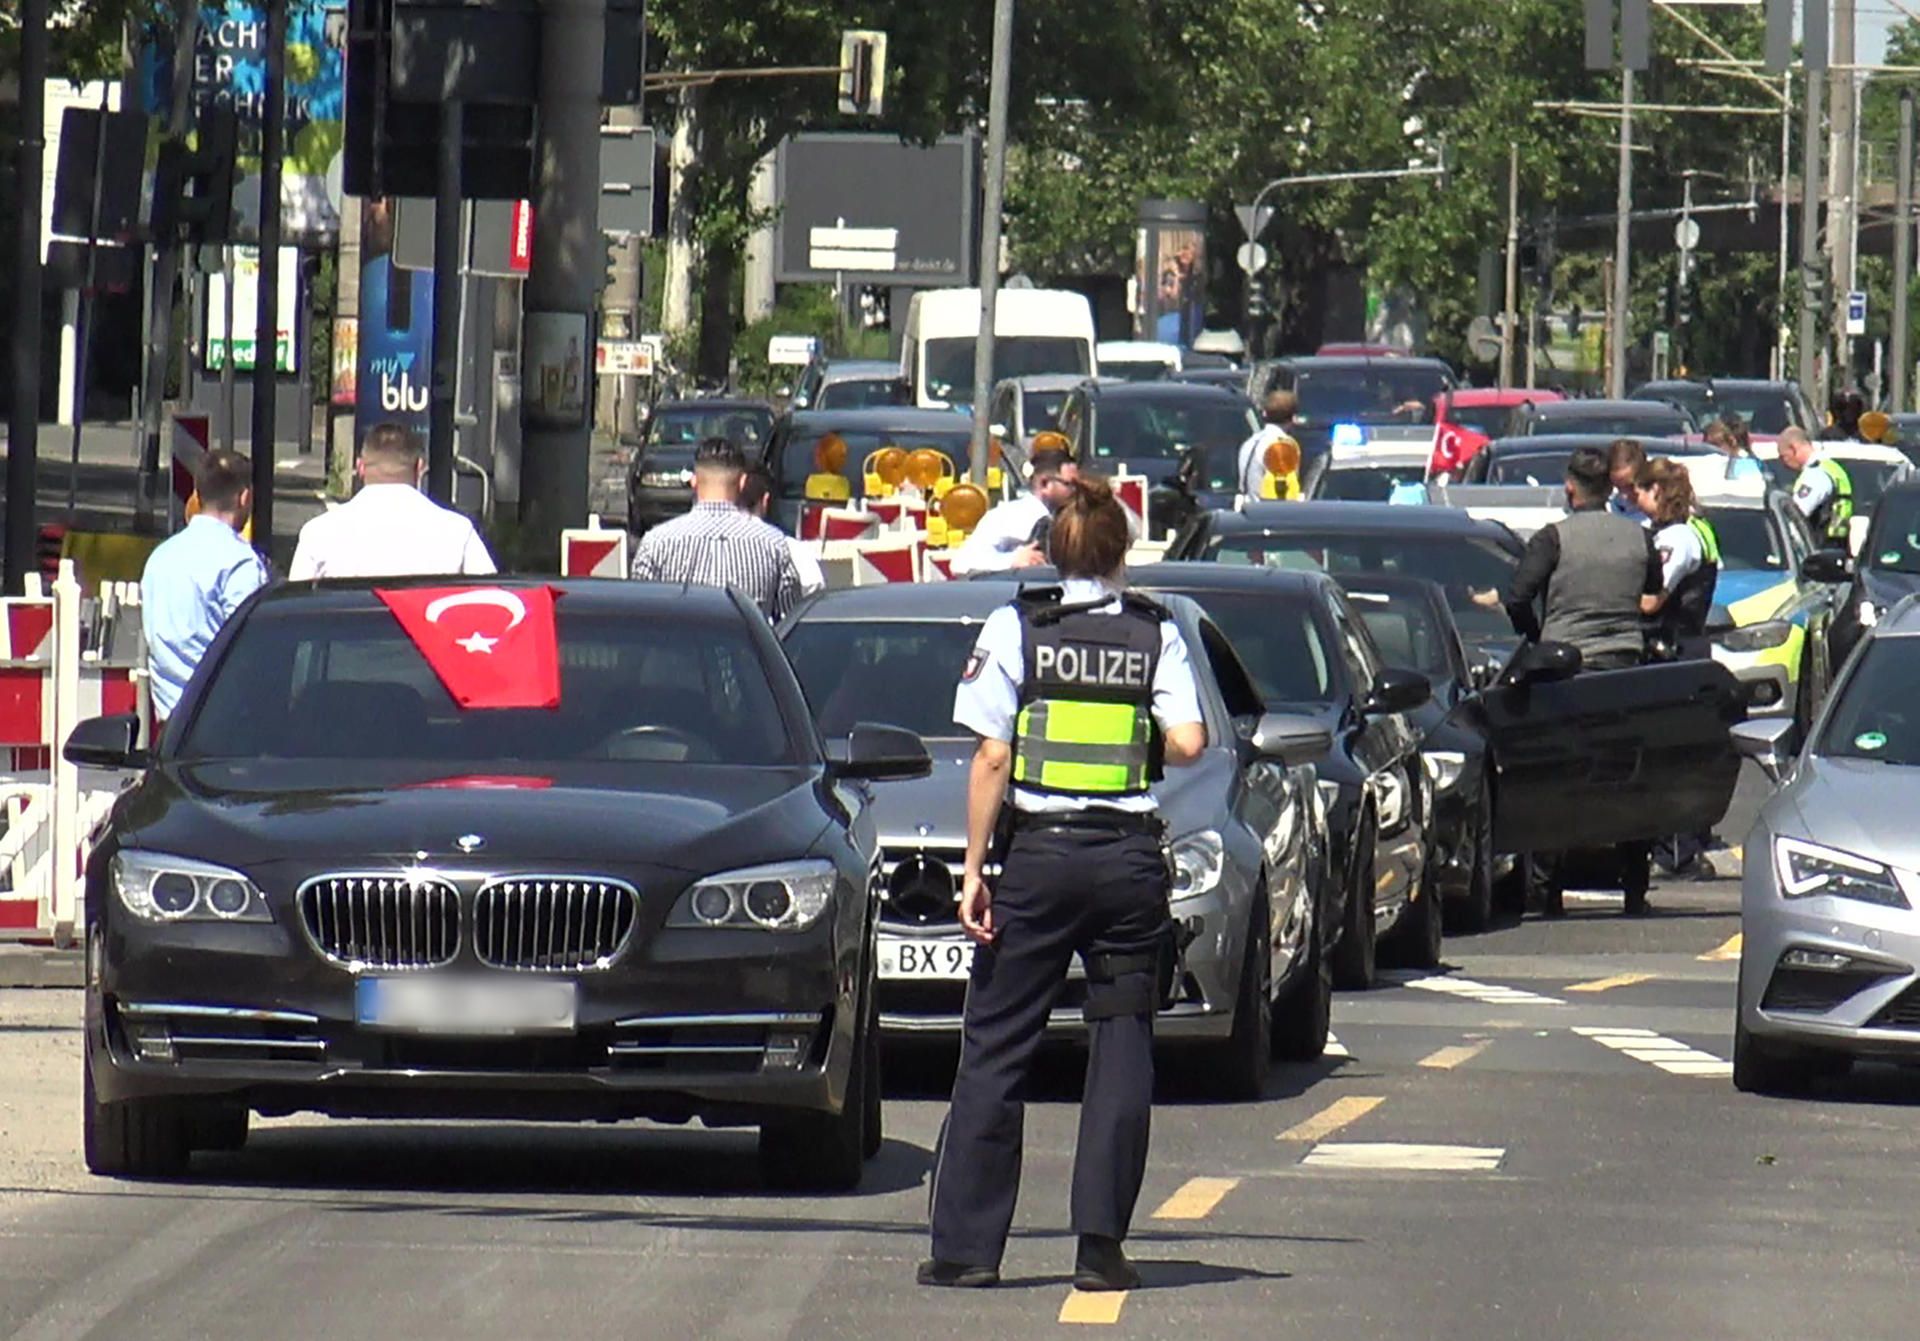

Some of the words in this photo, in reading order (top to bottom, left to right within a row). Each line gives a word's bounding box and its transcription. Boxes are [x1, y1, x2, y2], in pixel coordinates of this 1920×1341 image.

[195, 54, 233, 82] ER
[370, 357, 399, 384] my
[382, 371, 428, 412] blu
[1036, 645, 1149, 685] POLIZEI
[899, 944, 938, 973] BX
